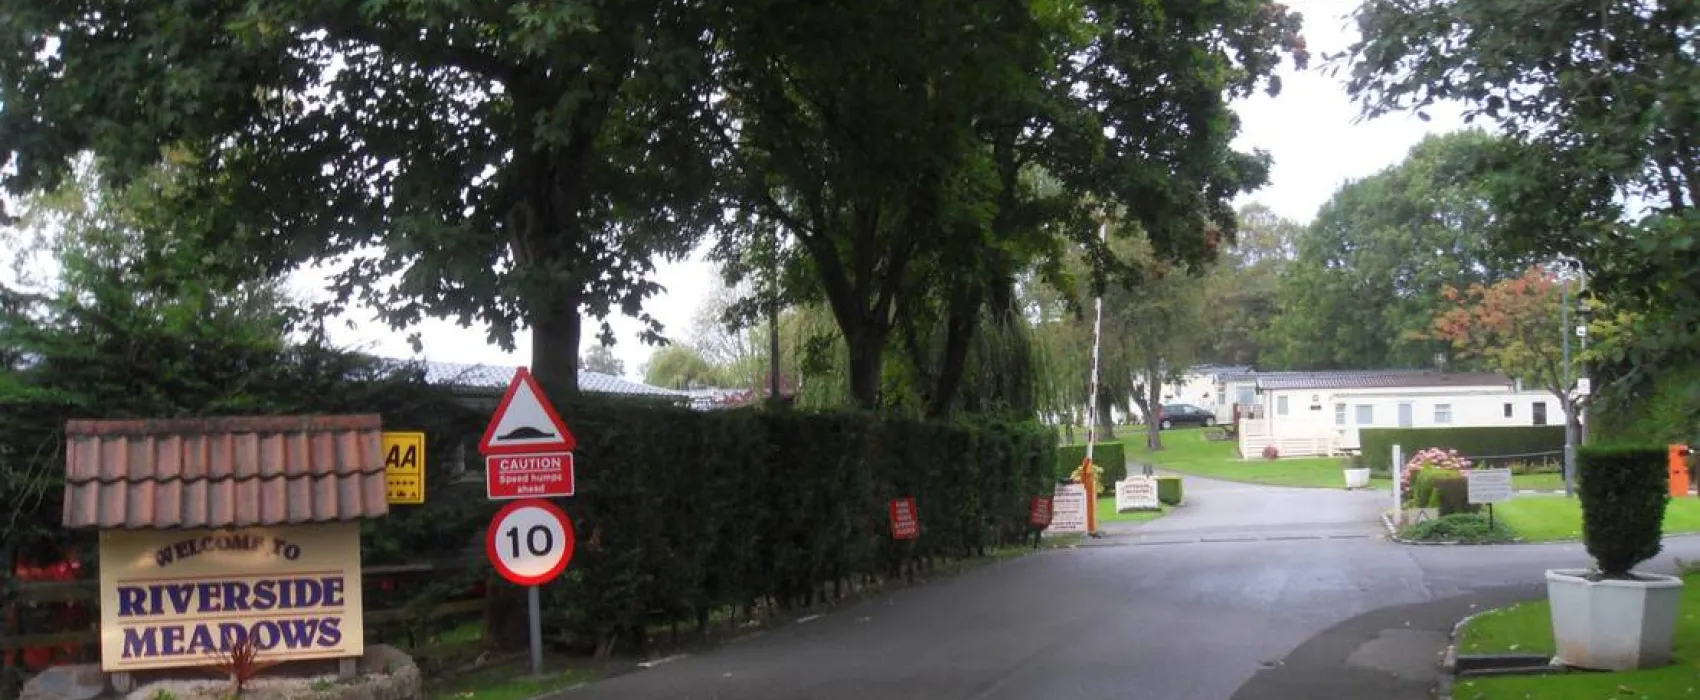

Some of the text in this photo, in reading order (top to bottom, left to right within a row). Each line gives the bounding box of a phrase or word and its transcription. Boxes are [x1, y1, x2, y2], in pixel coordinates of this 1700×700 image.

[386, 444, 416, 468] AA
[500, 457, 562, 470] CAUTION
[499, 473, 562, 484] Speed humps
[517, 484, 546, 494] ahead
[273, 538, 301, 561] TO
[506, 524, 553, 558] 10
[117, 577, 344, 617] RIVERSIDE
[122, 617, 342, 658] MEADOWS
